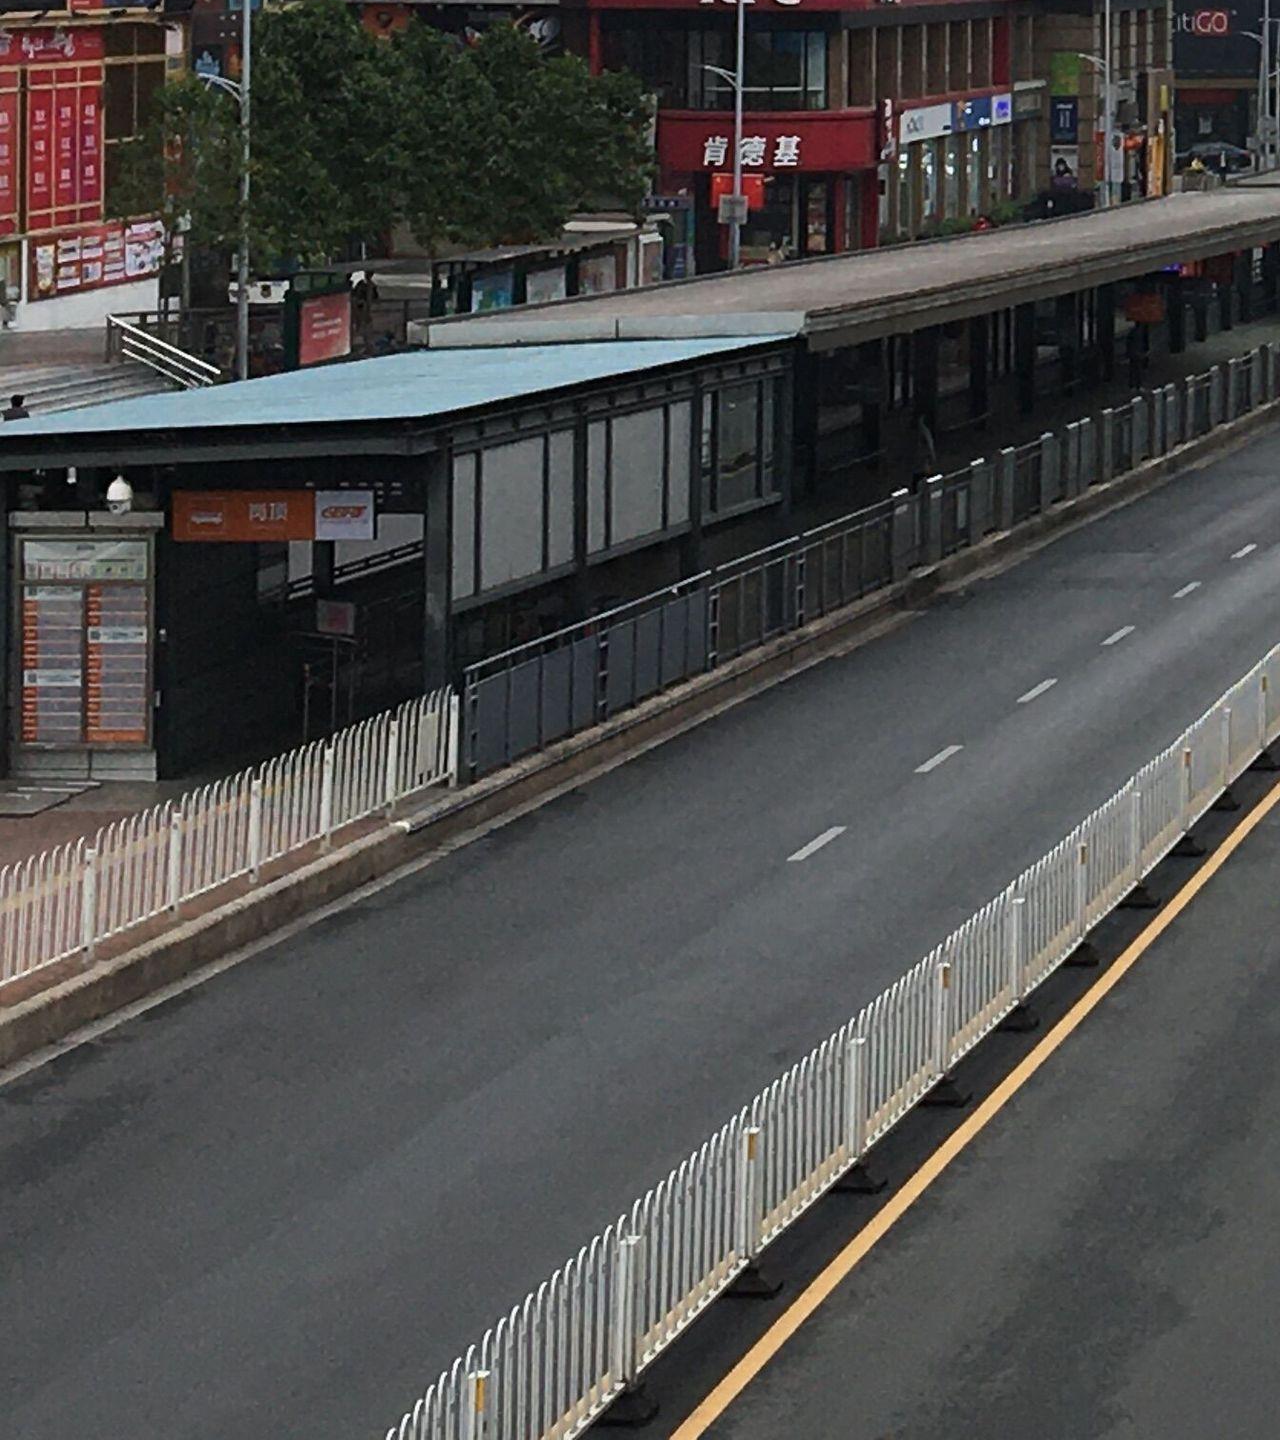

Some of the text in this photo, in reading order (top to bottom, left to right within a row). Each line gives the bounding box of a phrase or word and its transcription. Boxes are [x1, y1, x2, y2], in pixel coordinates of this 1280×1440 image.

[1177, 11, 1228, 33] itiGO
[702, 135, 802, 168] 肯德基
